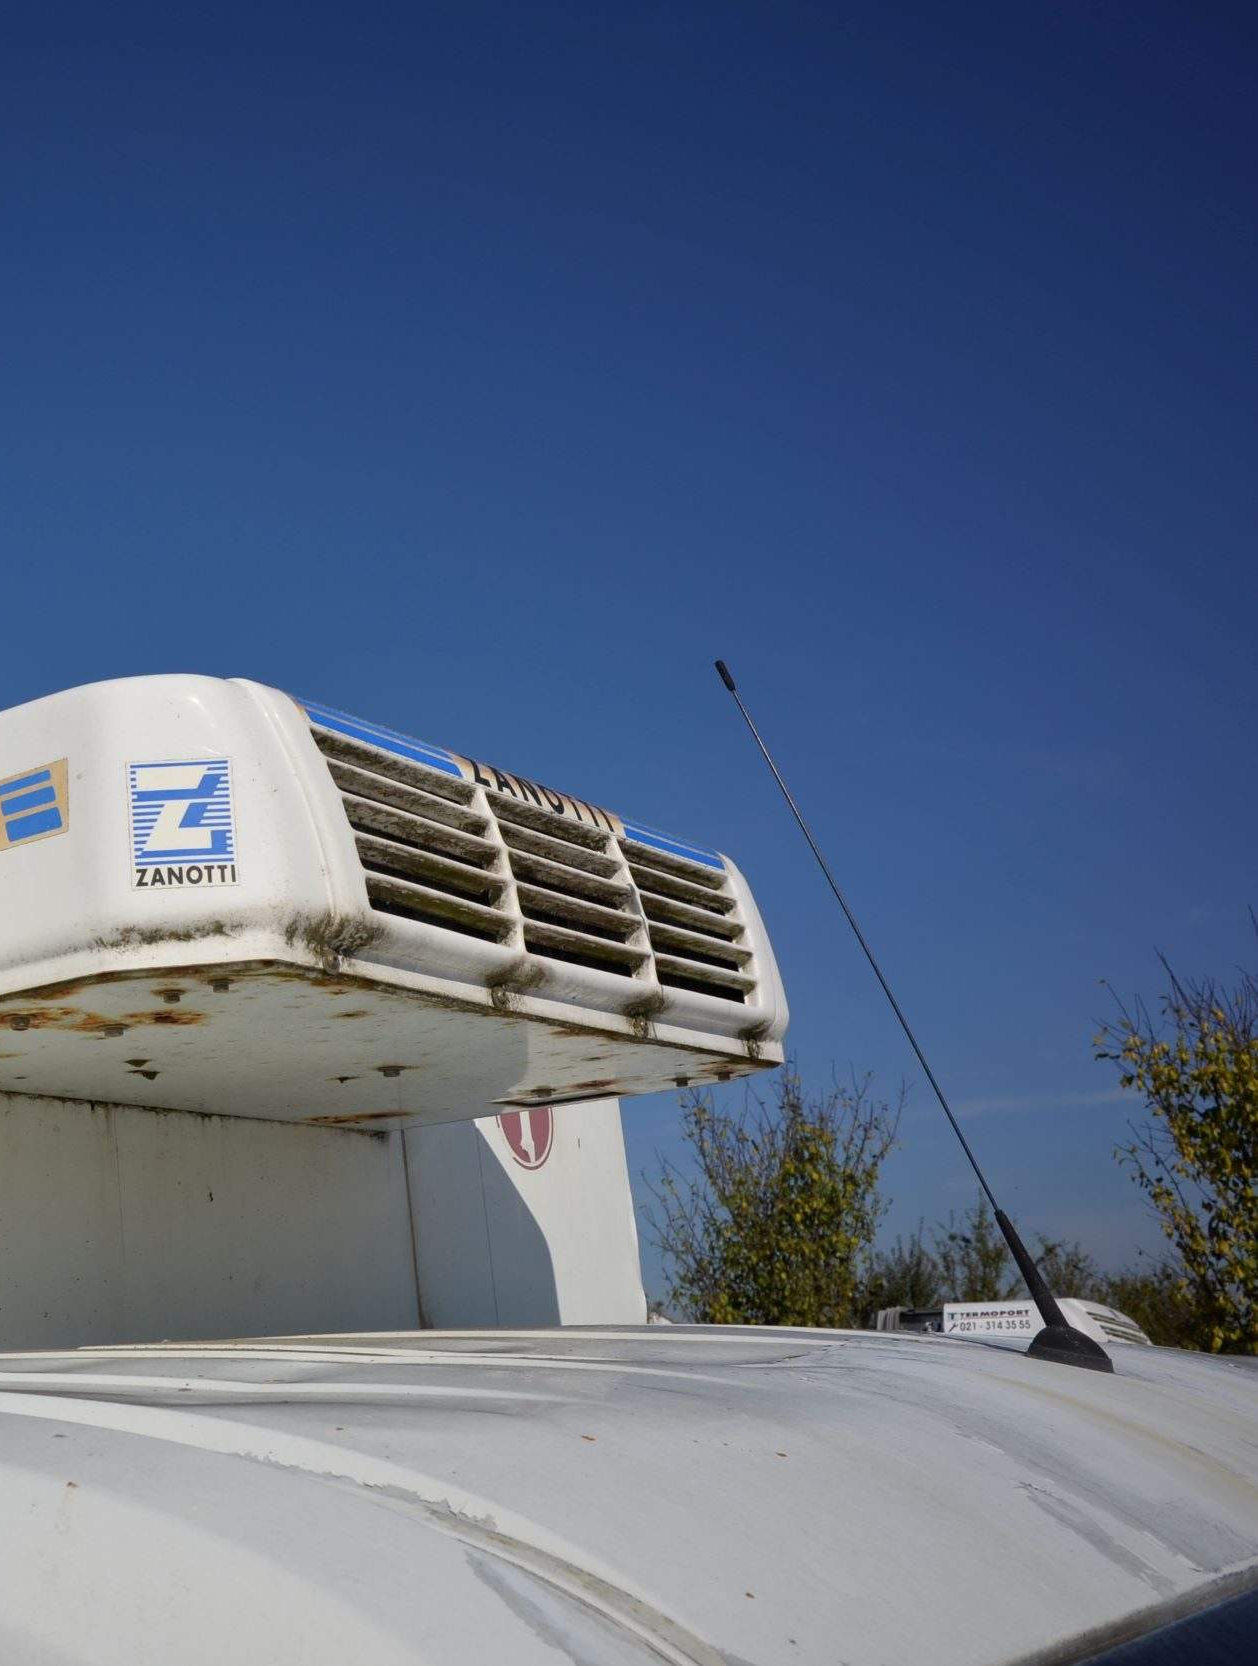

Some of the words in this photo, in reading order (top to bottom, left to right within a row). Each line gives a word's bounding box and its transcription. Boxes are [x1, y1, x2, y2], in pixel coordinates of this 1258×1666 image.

[135, 865, 236, 887] ZANOTTI
[960, 1310, 1030, 1318] TERMOPORT
[960, 1322, 976, 1331] 021
[986, 1321, 1003, 1330] 314
[1005, 1321, 1017, 1329] 35
[1019, 1320, 1031, 1329] 55
